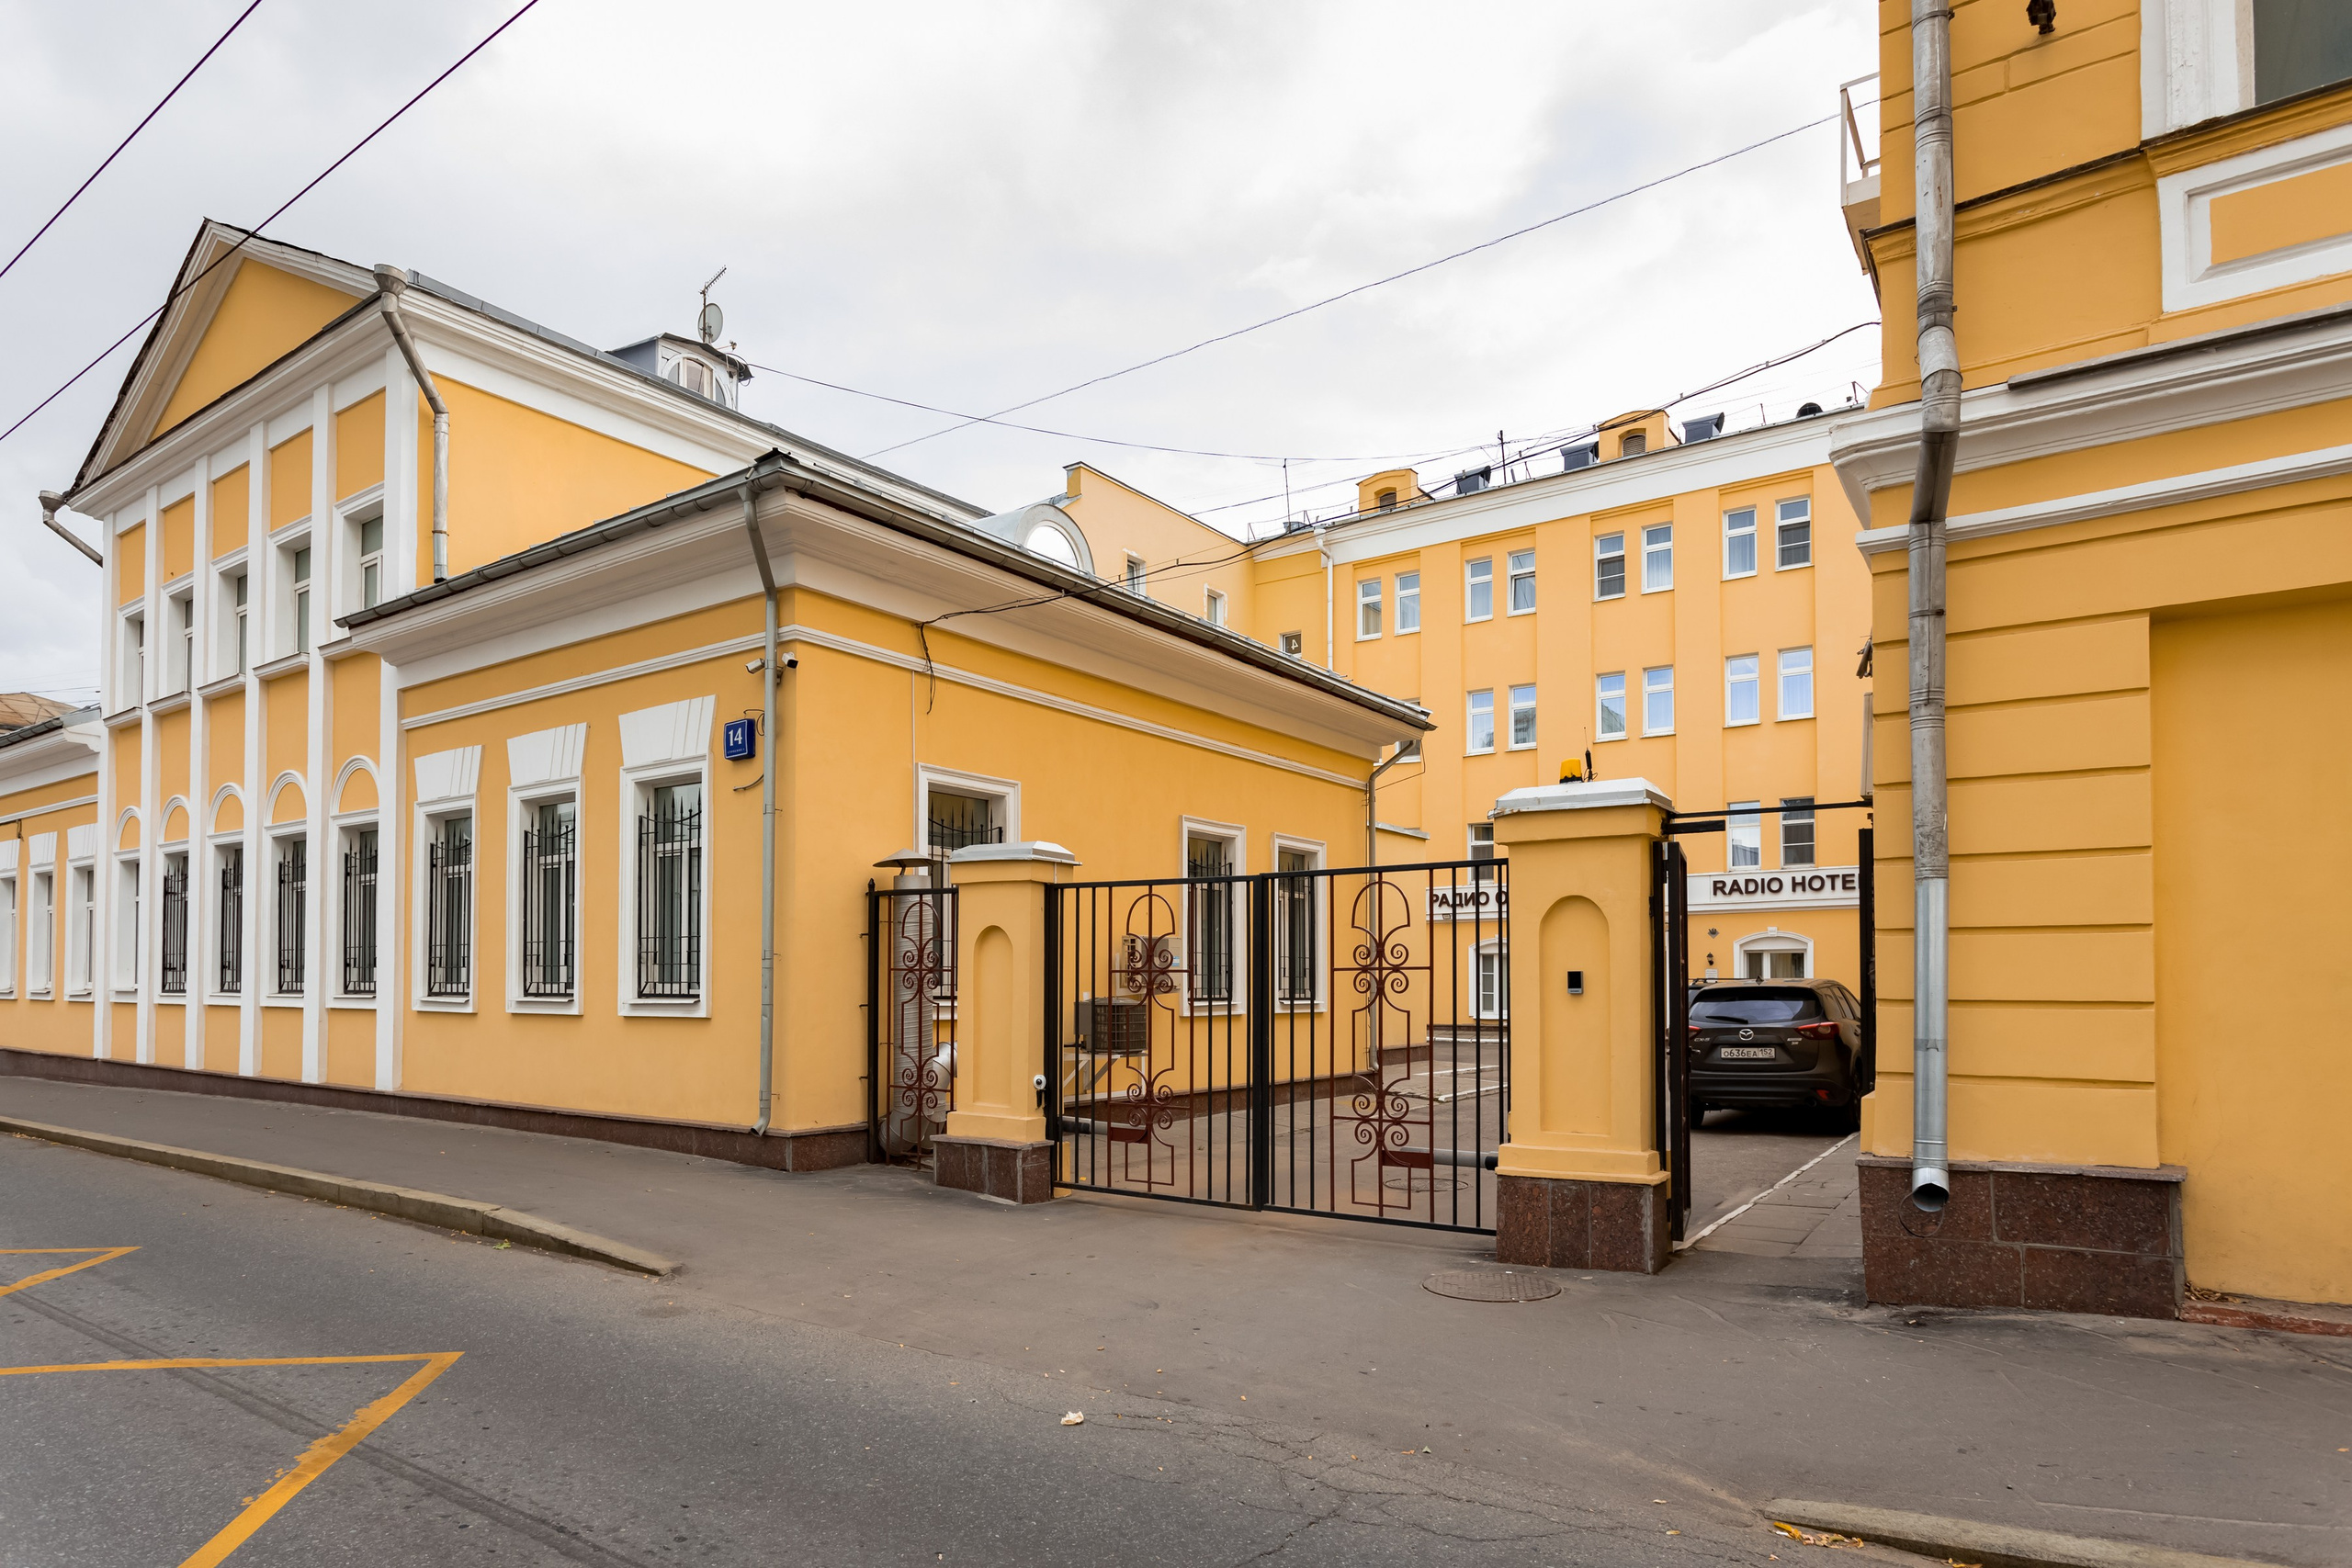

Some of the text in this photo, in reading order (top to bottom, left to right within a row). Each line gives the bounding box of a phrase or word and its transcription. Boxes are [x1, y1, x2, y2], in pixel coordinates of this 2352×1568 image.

[729, 728, 742, 746] 14
[1713, 874, 1860, 896] RADIO HOTE
[1431, 891, 1490, 908] РАДИО
